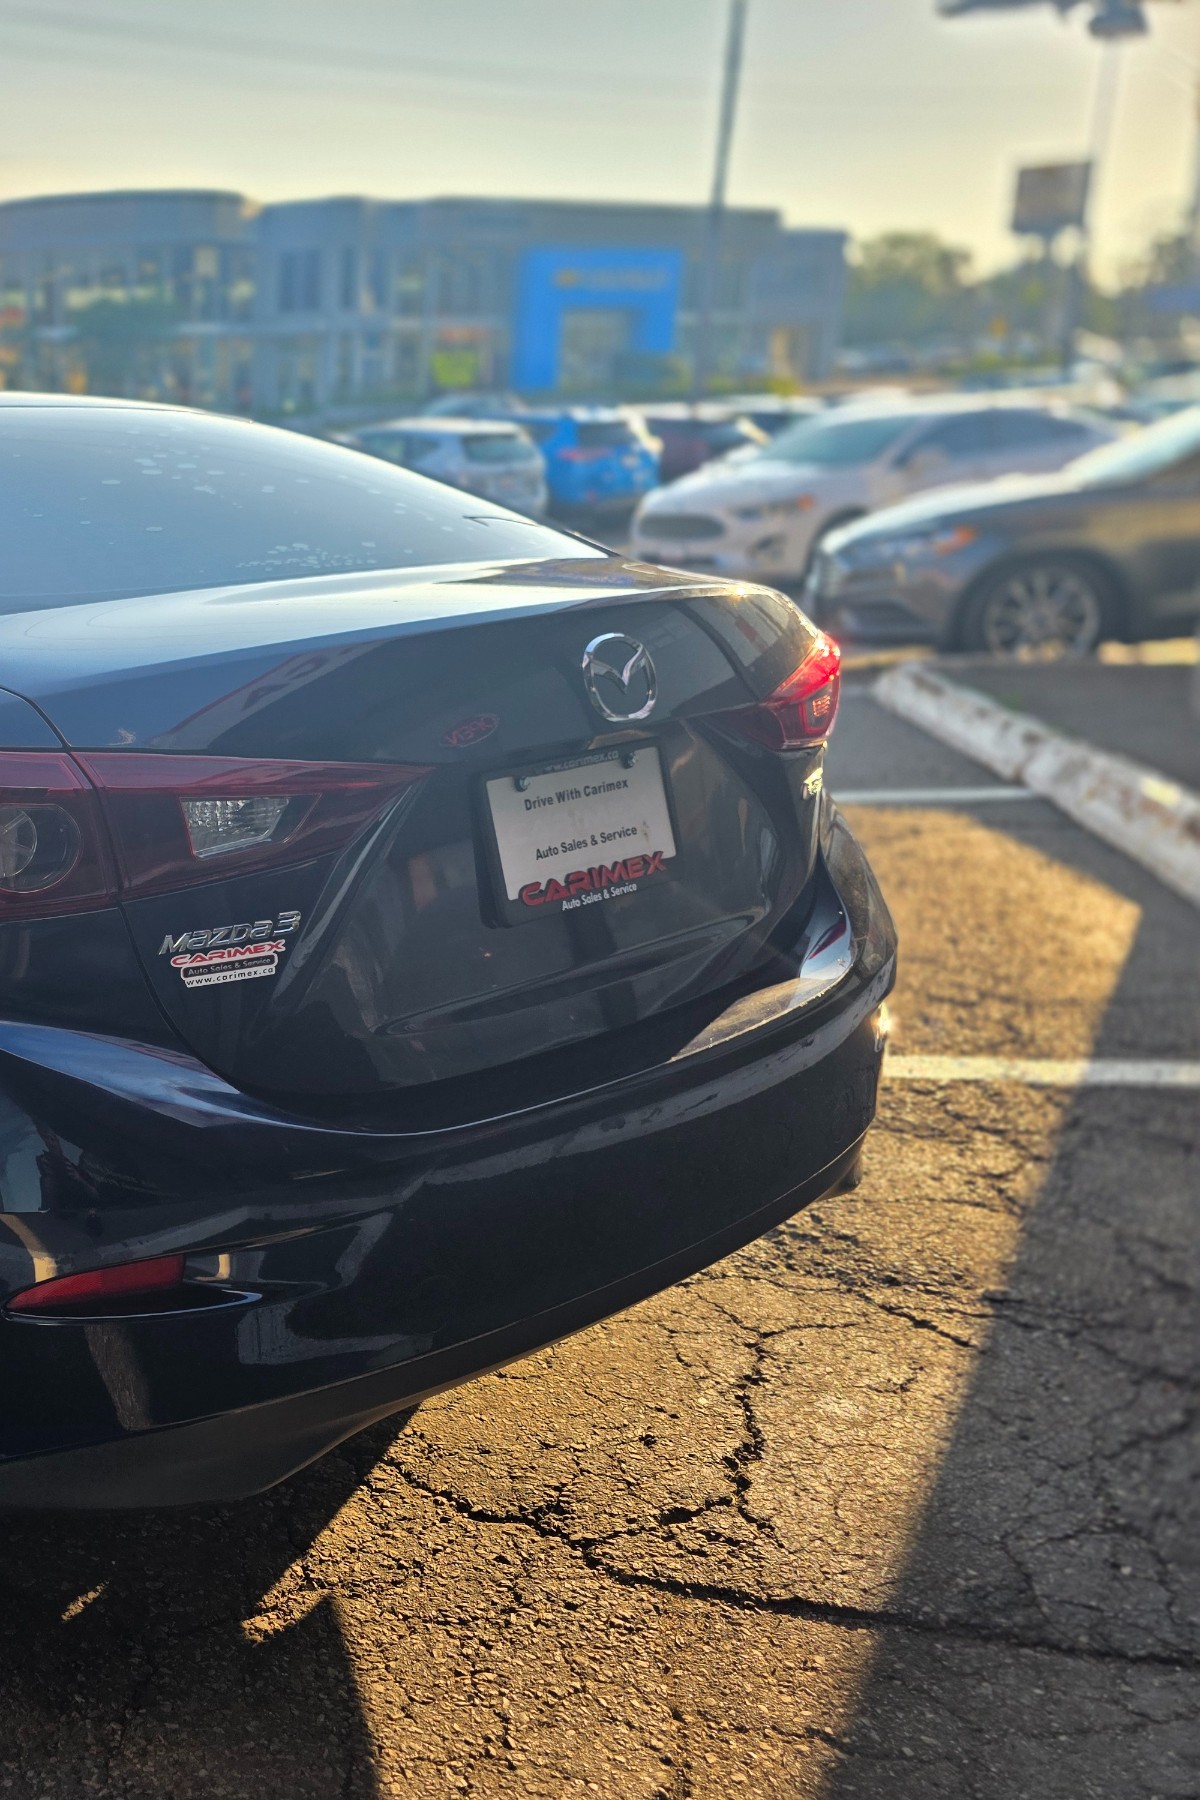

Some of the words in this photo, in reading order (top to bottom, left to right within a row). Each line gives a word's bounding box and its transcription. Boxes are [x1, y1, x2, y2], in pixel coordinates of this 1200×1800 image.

[524, 796, 554, 811] Drive
[555, 788, 581, 804] With
[582, 779, 628, 797] Carimex
[536, 845, 559, 860] Auto
[560, 839, 588, 853] Sales
[590, 834, 598, 846] &
[600, 826, 637, 844] Service
[519, 851, 666, 906] CARIMEX
[562, 898, 580, 911] Auto
[582, 892, 602, 905] Sales
[604, 888, 610, 899] &
[611, 882, 637, 897] Service
[172, 941, 284, 966] CARIMEX
[188, 967, 208, 976] Auto
[210, 964, 233, 972] Sales
[243, 958, 271, 967] Service
[186, 967, 274, 986] www.carimex.ca
